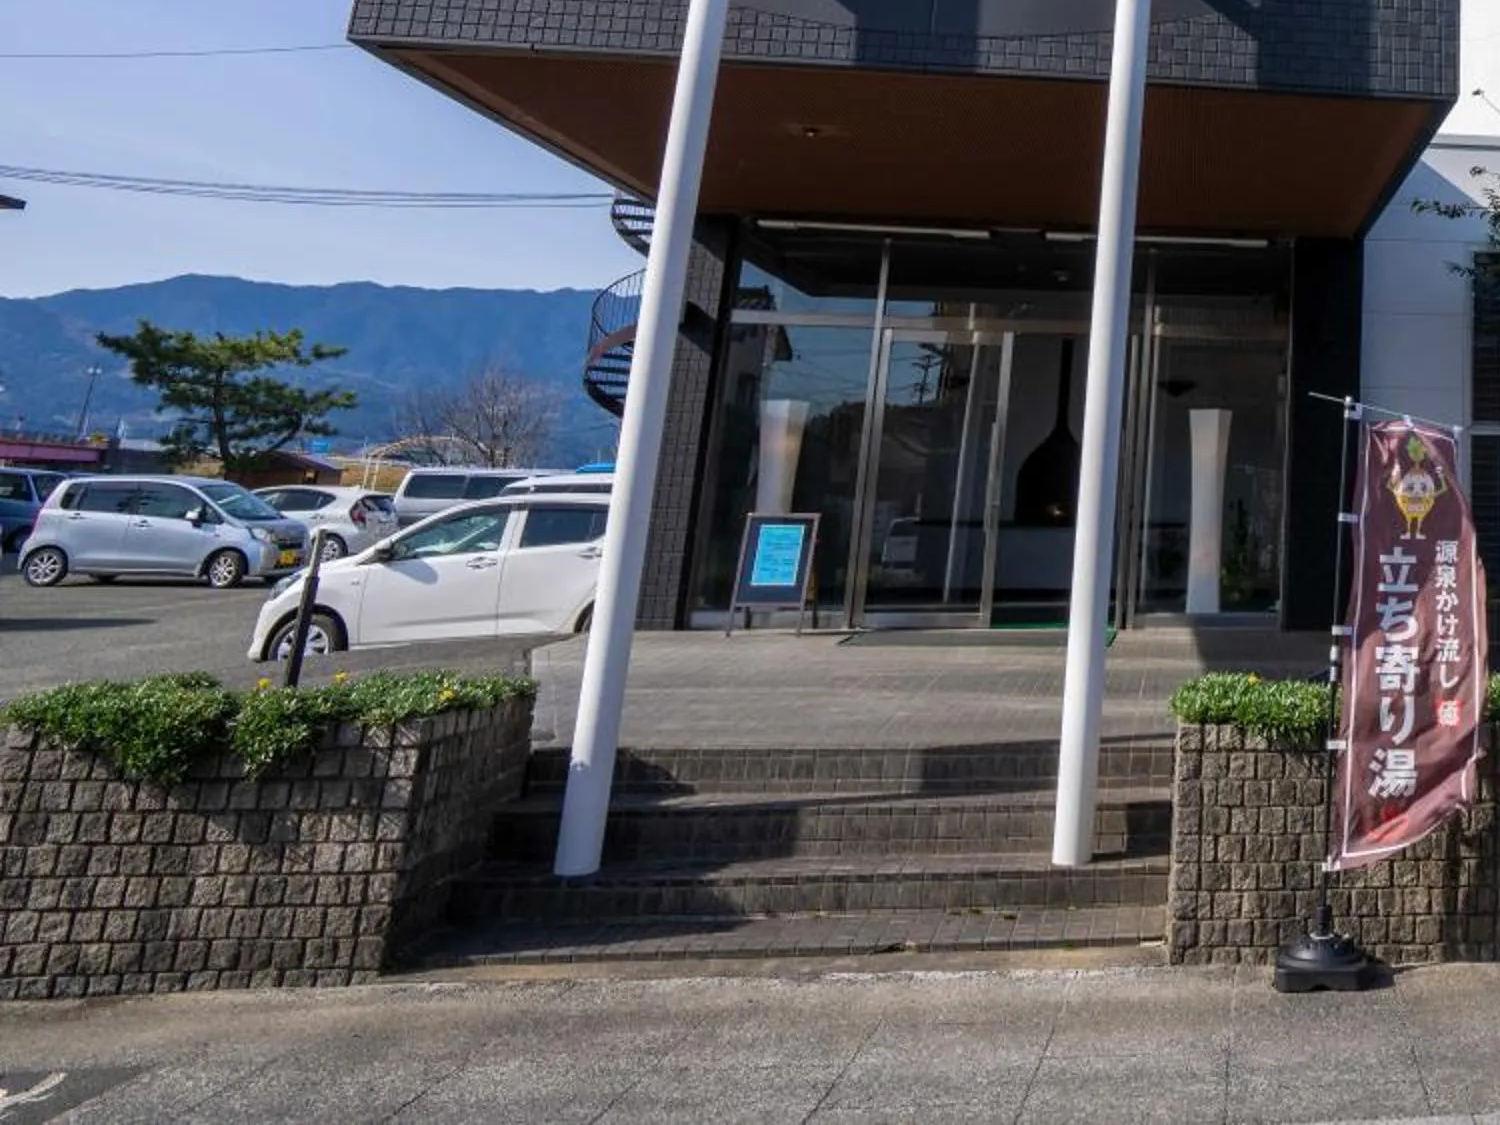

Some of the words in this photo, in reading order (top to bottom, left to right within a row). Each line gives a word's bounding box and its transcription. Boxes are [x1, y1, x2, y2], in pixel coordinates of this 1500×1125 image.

[1368, 546, 1421, 799] 立ち寄り湯
